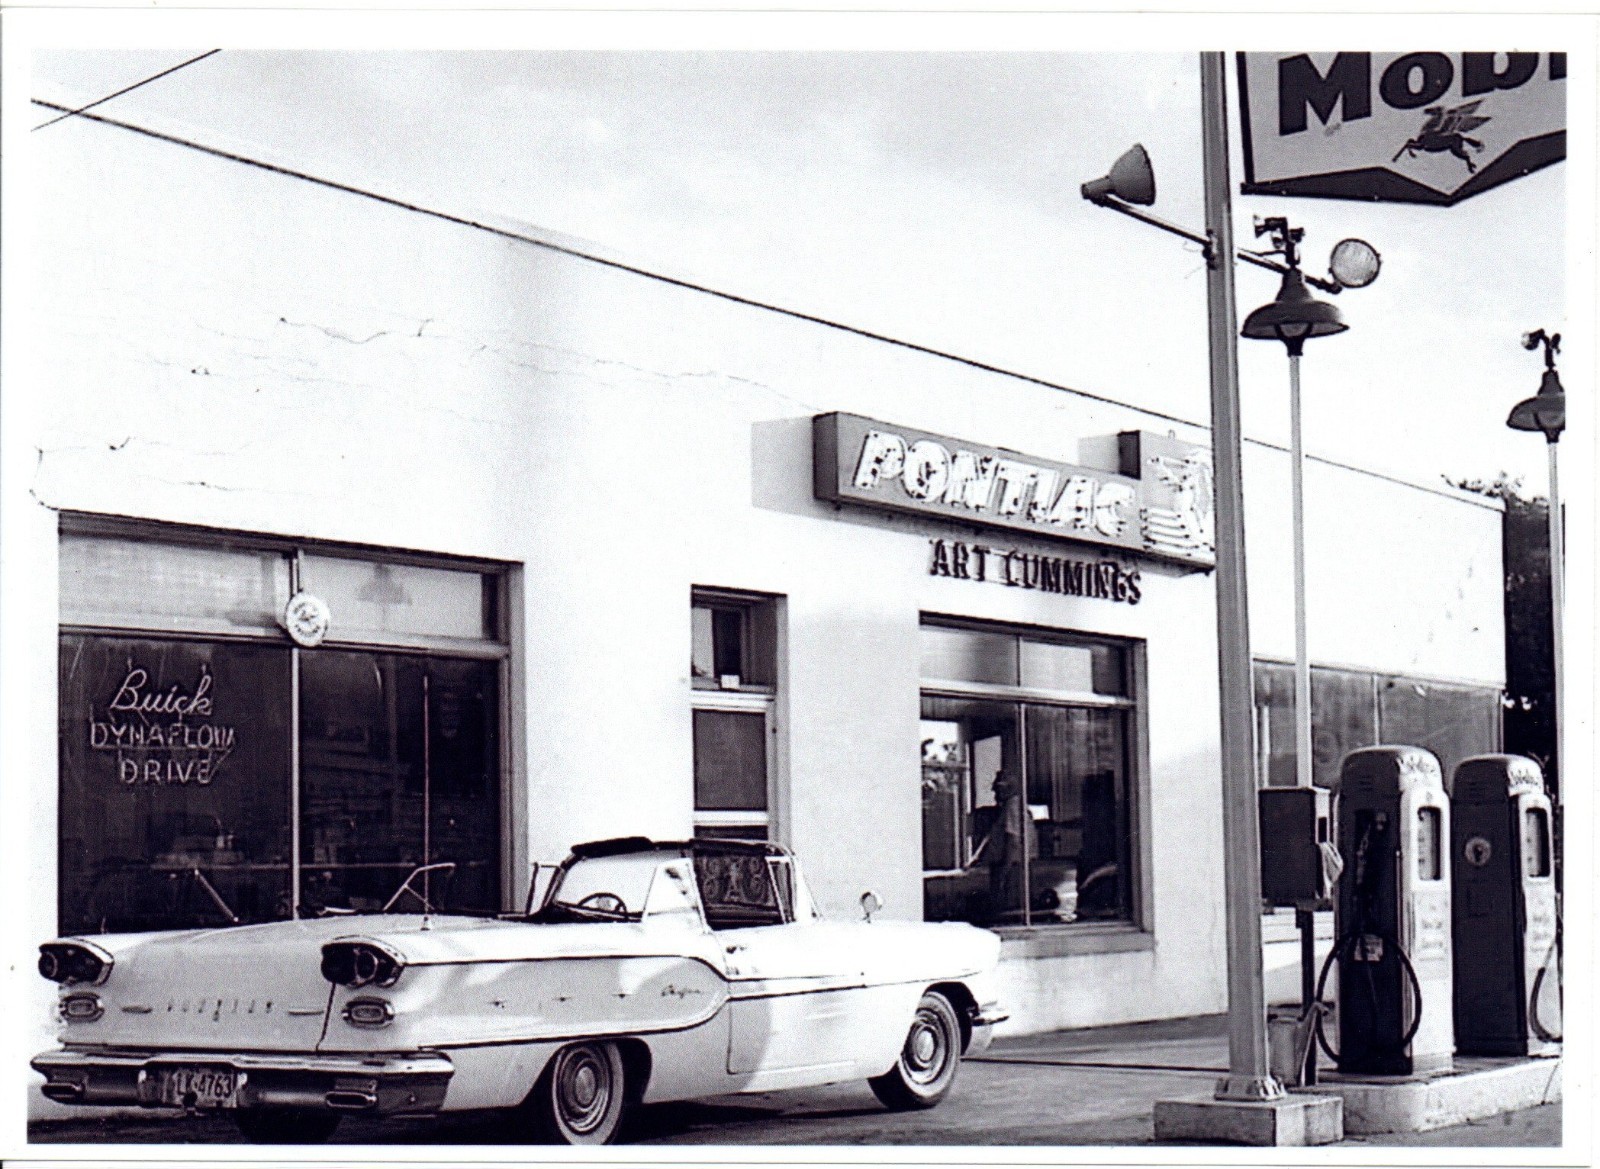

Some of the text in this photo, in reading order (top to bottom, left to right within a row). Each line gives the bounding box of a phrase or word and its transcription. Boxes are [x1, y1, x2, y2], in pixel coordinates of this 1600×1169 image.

[1278, 51, 1567, 137] Mob
[852, 429, 1137, 537] PONTIAC
[929, 538, 1142, 605] ART CUMMINGS
[110, 668, 212, 716] Buick
[90, 722, 235, 750] DYNAFLOW
[120, 758, 212, 784] DRIVE
